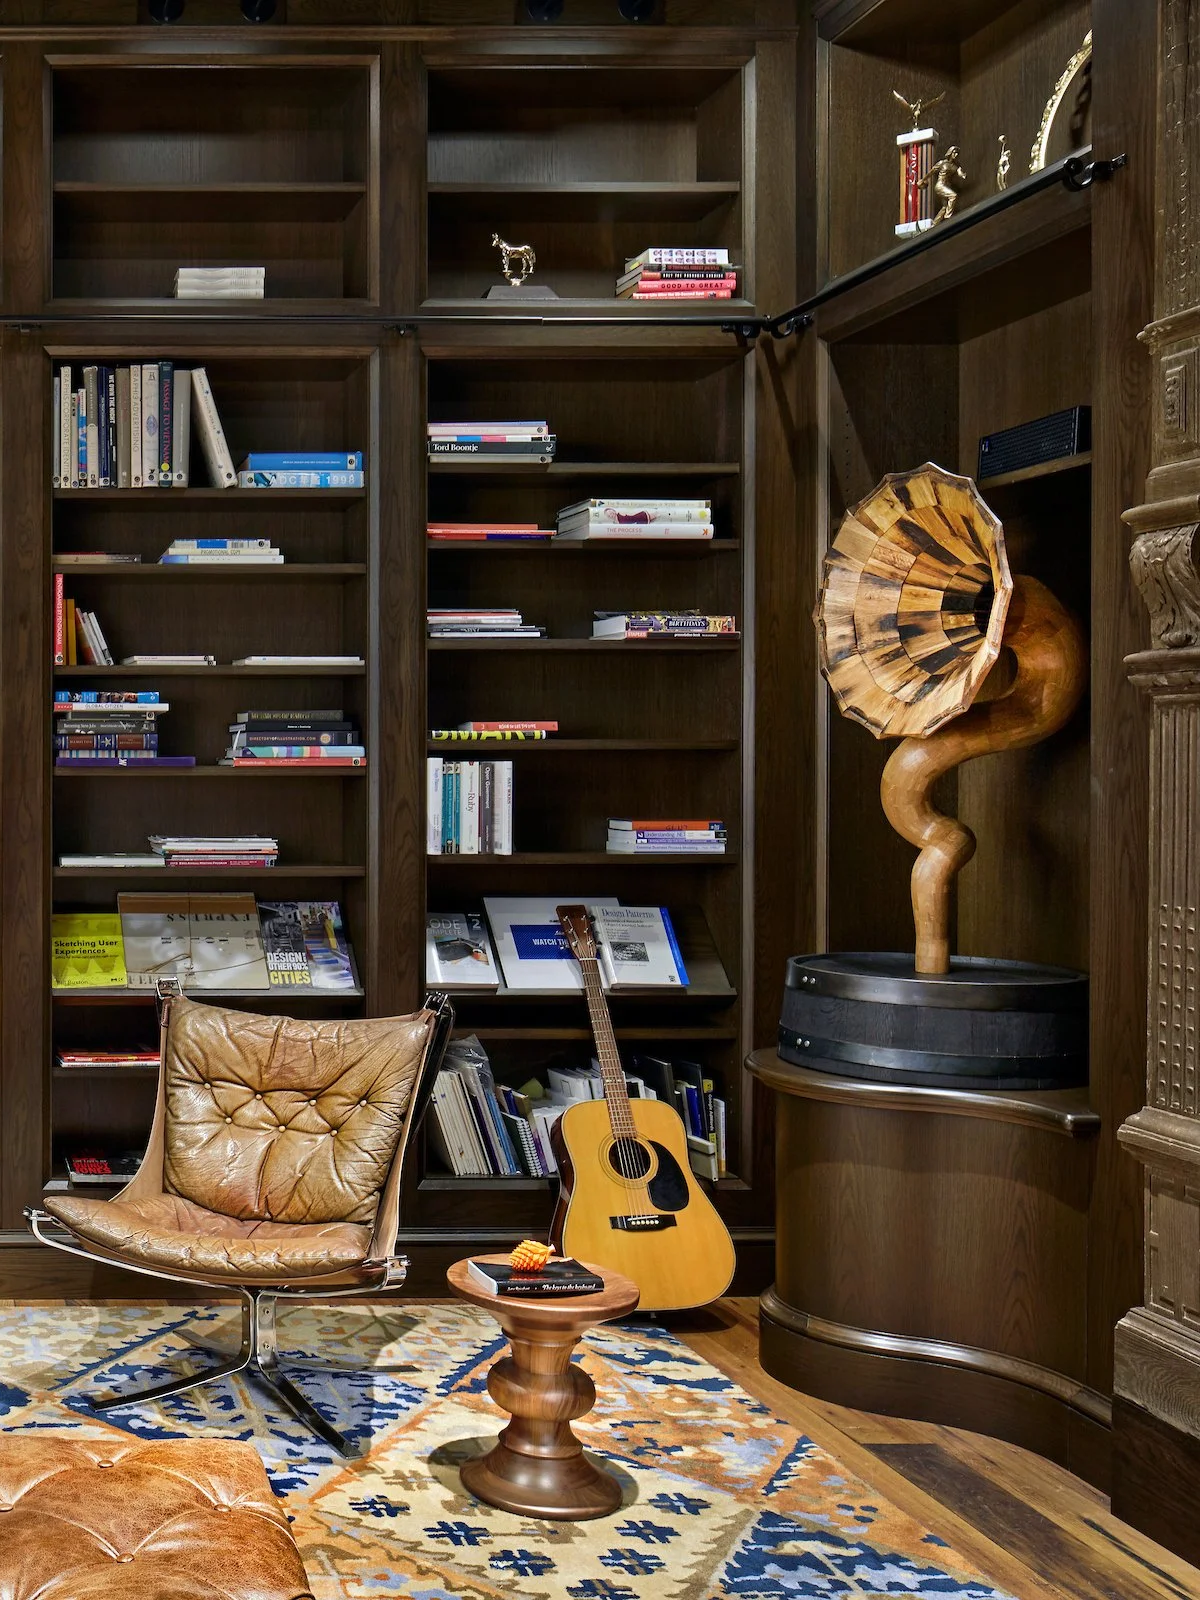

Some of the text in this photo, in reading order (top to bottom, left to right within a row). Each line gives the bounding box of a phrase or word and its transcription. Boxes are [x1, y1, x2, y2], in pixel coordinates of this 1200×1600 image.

[108, 374, 114, 382] WE
[162, 378, 170, 464] PASSAGE TO VIETNAM
[132, 401, 140, 452] ADVERTISING
[451, 444, 478, 452] Boontje
[326, 474, 355, 485] 1998
[467, 792, 476, 813] Ruby
[602, 908, 654, 918] Design Patterns
[430, 918, 462, 930] ODE
[472, 919, 481, 929] 2
[54, 940, 96, 948] Sketching
[55, 948, 106, 956] Experiences
[266, 952, 302, 962] DESIGN
[268, 962, 308, 970] OTHER 90%
[270, 971, 311, 984] CITIES
